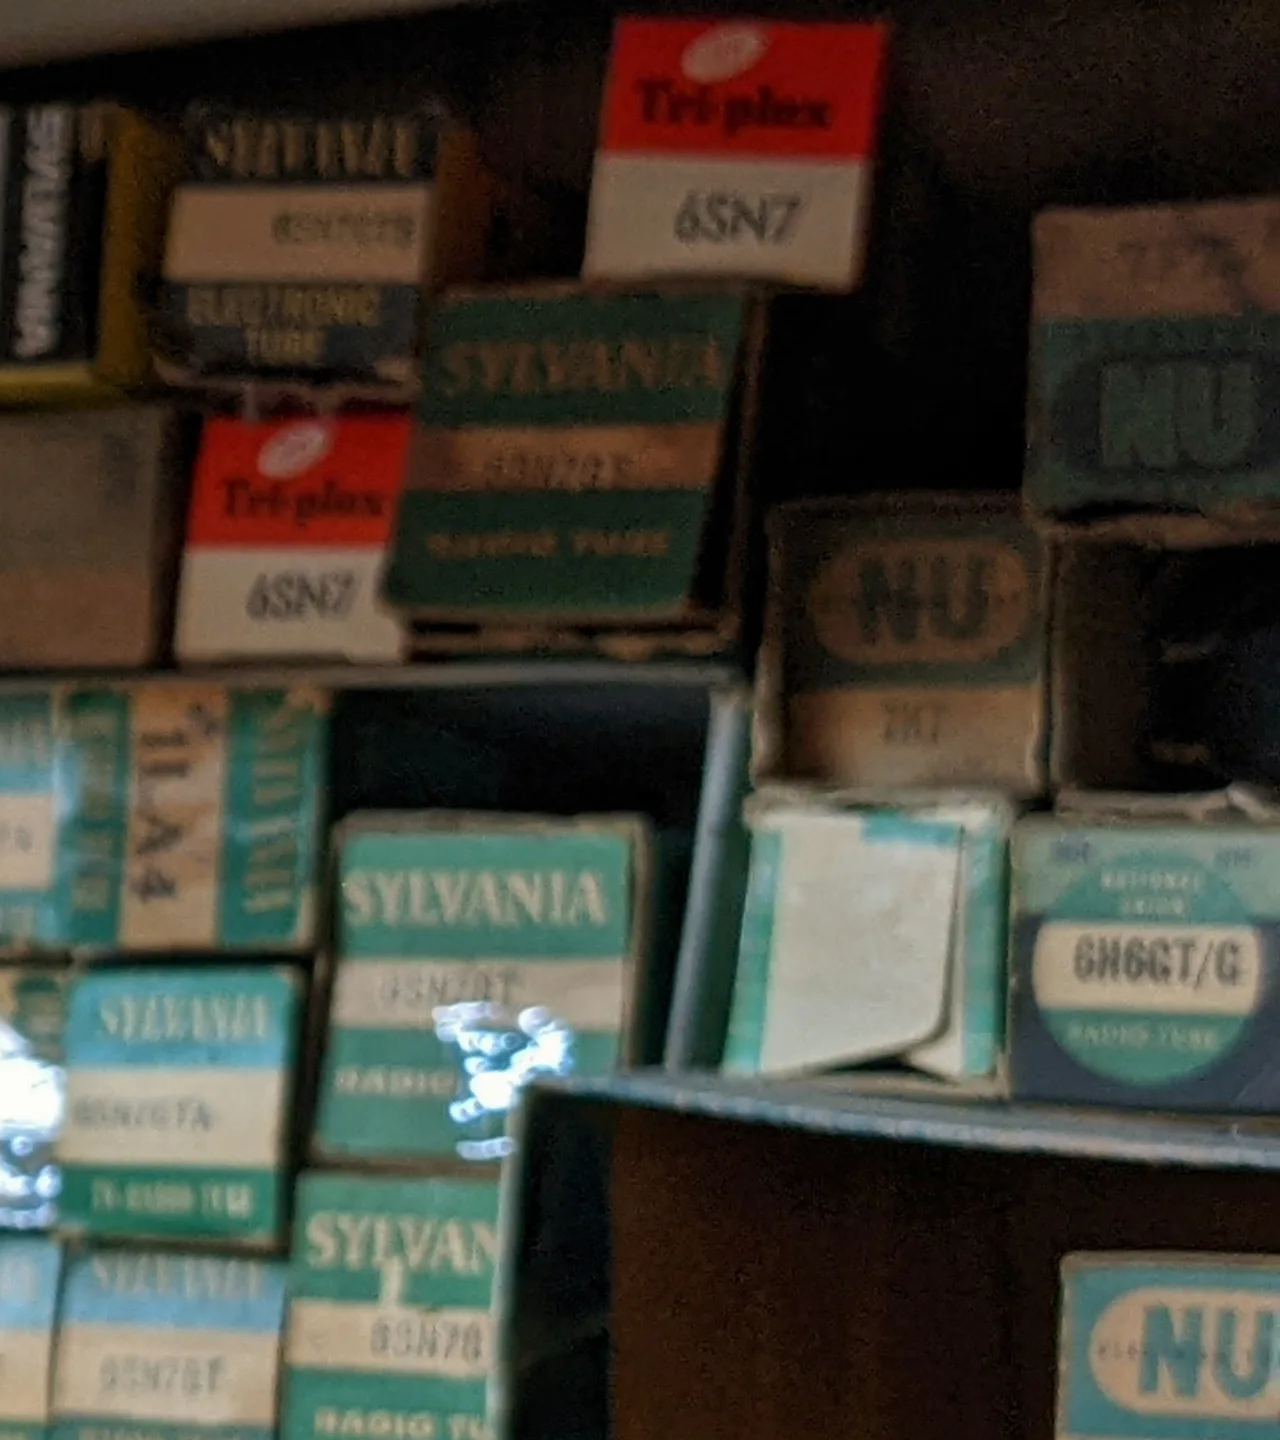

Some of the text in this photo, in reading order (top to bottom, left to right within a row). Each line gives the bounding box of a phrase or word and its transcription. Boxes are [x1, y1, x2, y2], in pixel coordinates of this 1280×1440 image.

[673, 190, 802, 246] 6SN7
[343, 868, 607, 928] SYLVANIA
[1141, 1303, 1274, 1398] NU
